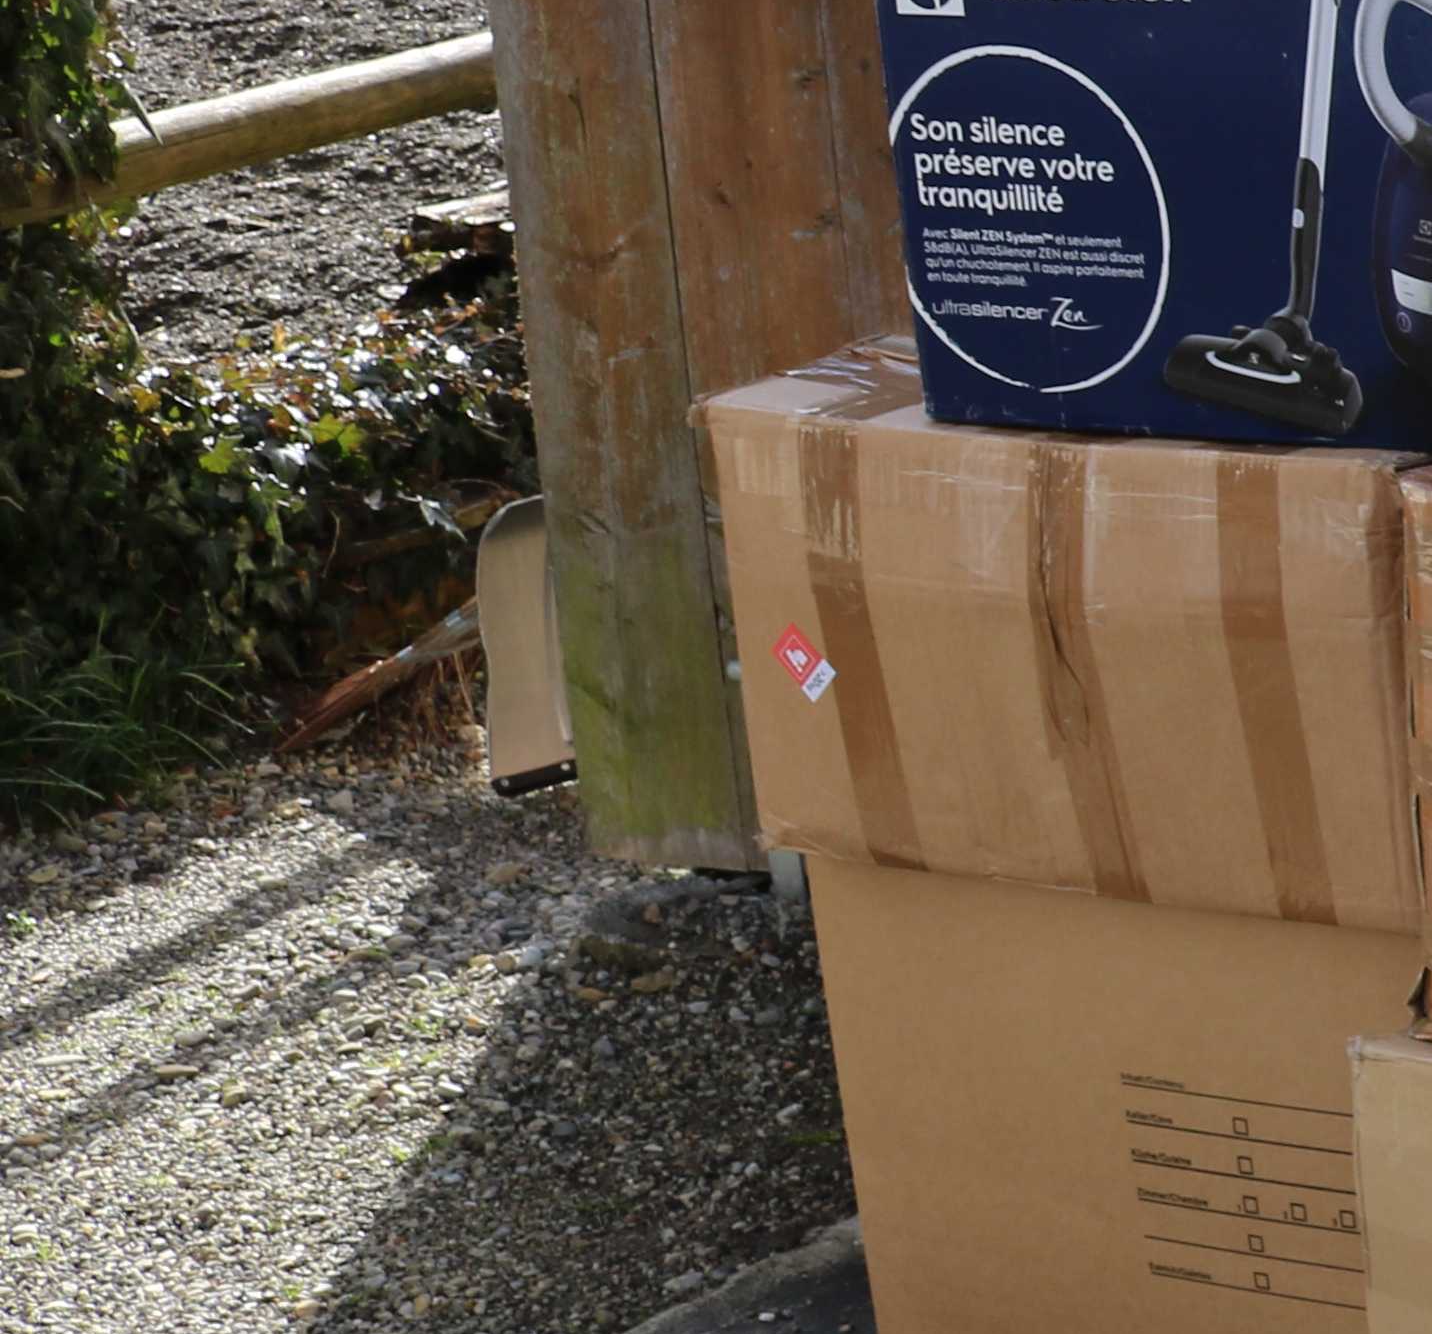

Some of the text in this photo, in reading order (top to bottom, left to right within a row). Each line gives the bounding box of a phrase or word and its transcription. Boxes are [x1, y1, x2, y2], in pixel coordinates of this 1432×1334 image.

[910, 112, 1066, 147] Son silence
[914, 147, 1115, 182] préserve votre
[917, 178, 1065, 216] tranquillité
[922, 227, 949, 240] Avec
[949, 228, 981, 241] Silent
[981, 228, 1005, 242] ZEN
[1055, 234, 1065, 245] et
[1066, 235, 1123, 248] seulement
[970, 244, 1146, 265] UltraSilencer ZEN est aussi discret
[927, 272, 970, 285] en toute
[1042, 264, 1075, 277] aspire
[1075, 264, 1146, 280] parfaitement
[932, 296, 1104, 331] ultrasilencer Zen
